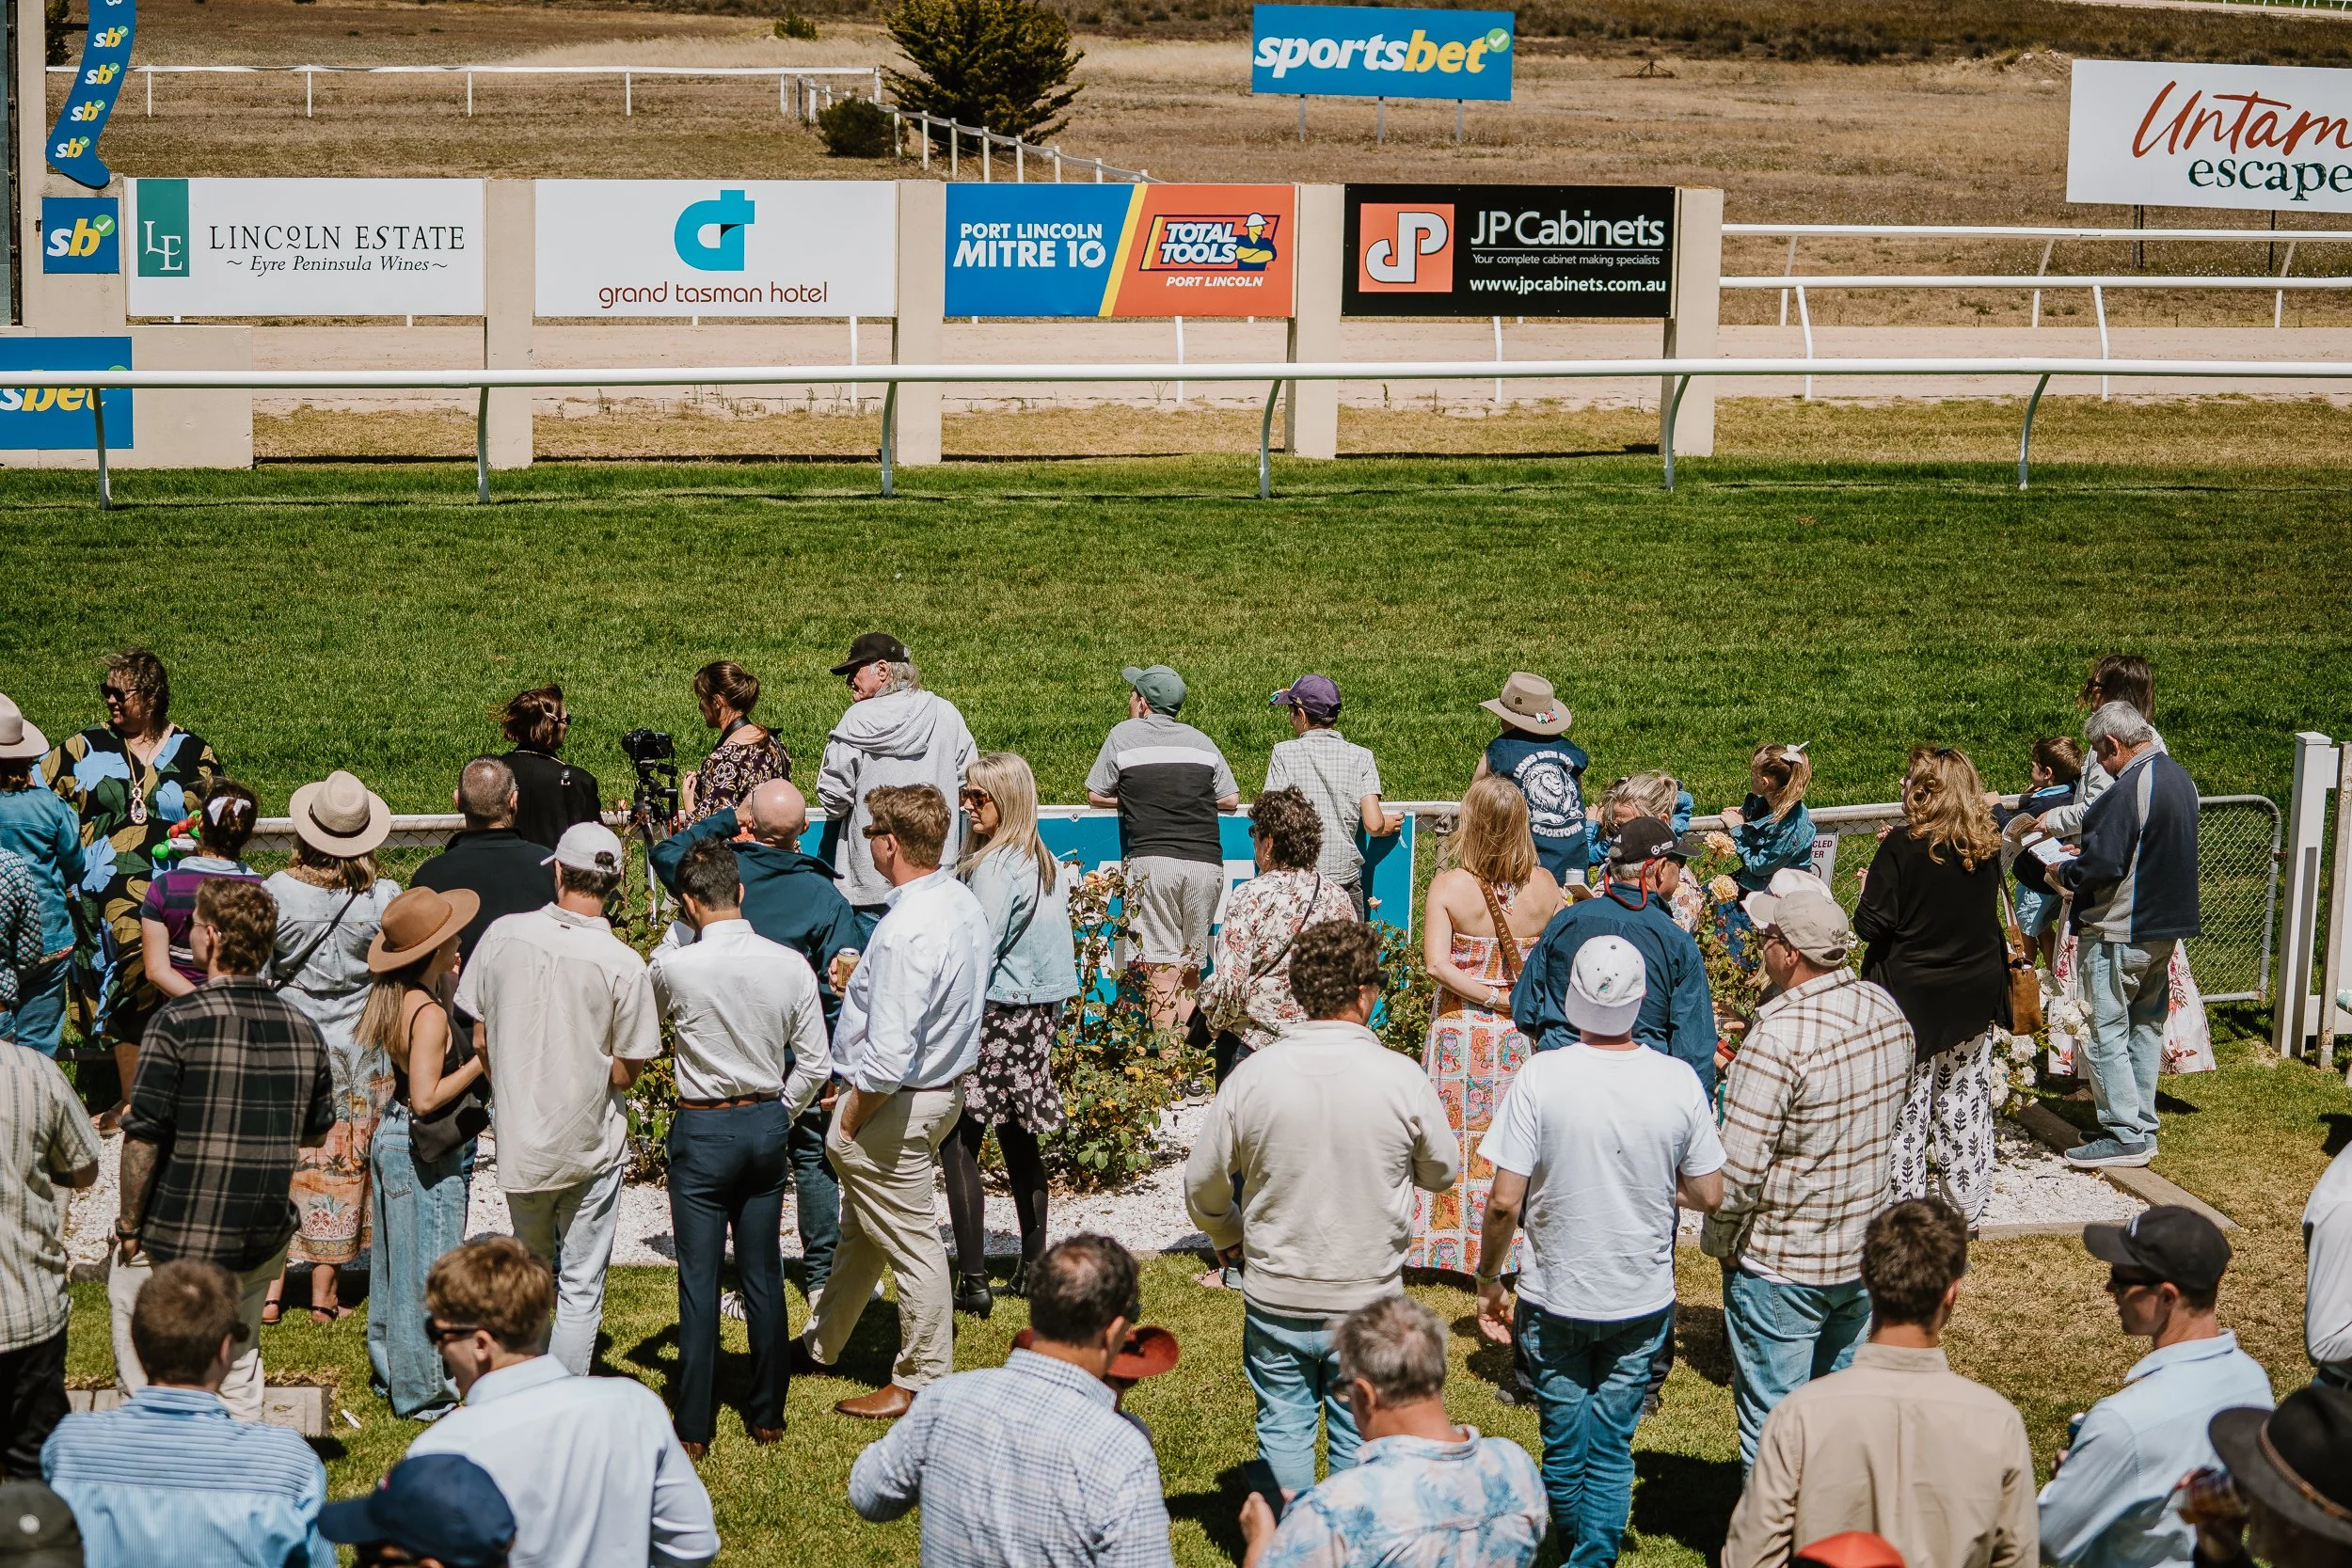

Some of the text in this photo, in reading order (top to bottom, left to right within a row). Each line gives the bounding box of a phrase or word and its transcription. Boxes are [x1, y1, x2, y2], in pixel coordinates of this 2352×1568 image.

[94, 27, 122, 48] sb
[1254, 29, 1488, 78] sportsbet
[85, 64, 113, 85] sb
[71, 102, 99, 120] sb
[56, 138, 85, 158] sb
[47, 218, 100, 257] sb
[210, 226, 465, 249] LINCOLN ESTATE
[961, 223, 1103, 239] PORT LINCOLN
[1164, 223, 1238, 243] TOTAL
[953, 241, 1106, 267] MITRE 10
[1159, 242, 1237, 264] TOOLS
[1472, 254, 1661, 267] Your complete cabinet making specialists
[250, 255, 429, 277] Eyre Peninsula Wines
[1166, 276, 1263, 287] PORT LINCOLN
[1470, 276, 1666, 294] www.jpcabinets.com.au
[599, 281, 827, 309] grand tasman hotel
[1513, 753, 1538, 780] LIONS
[1532, 821, 1583, 837] COOKTOWN
